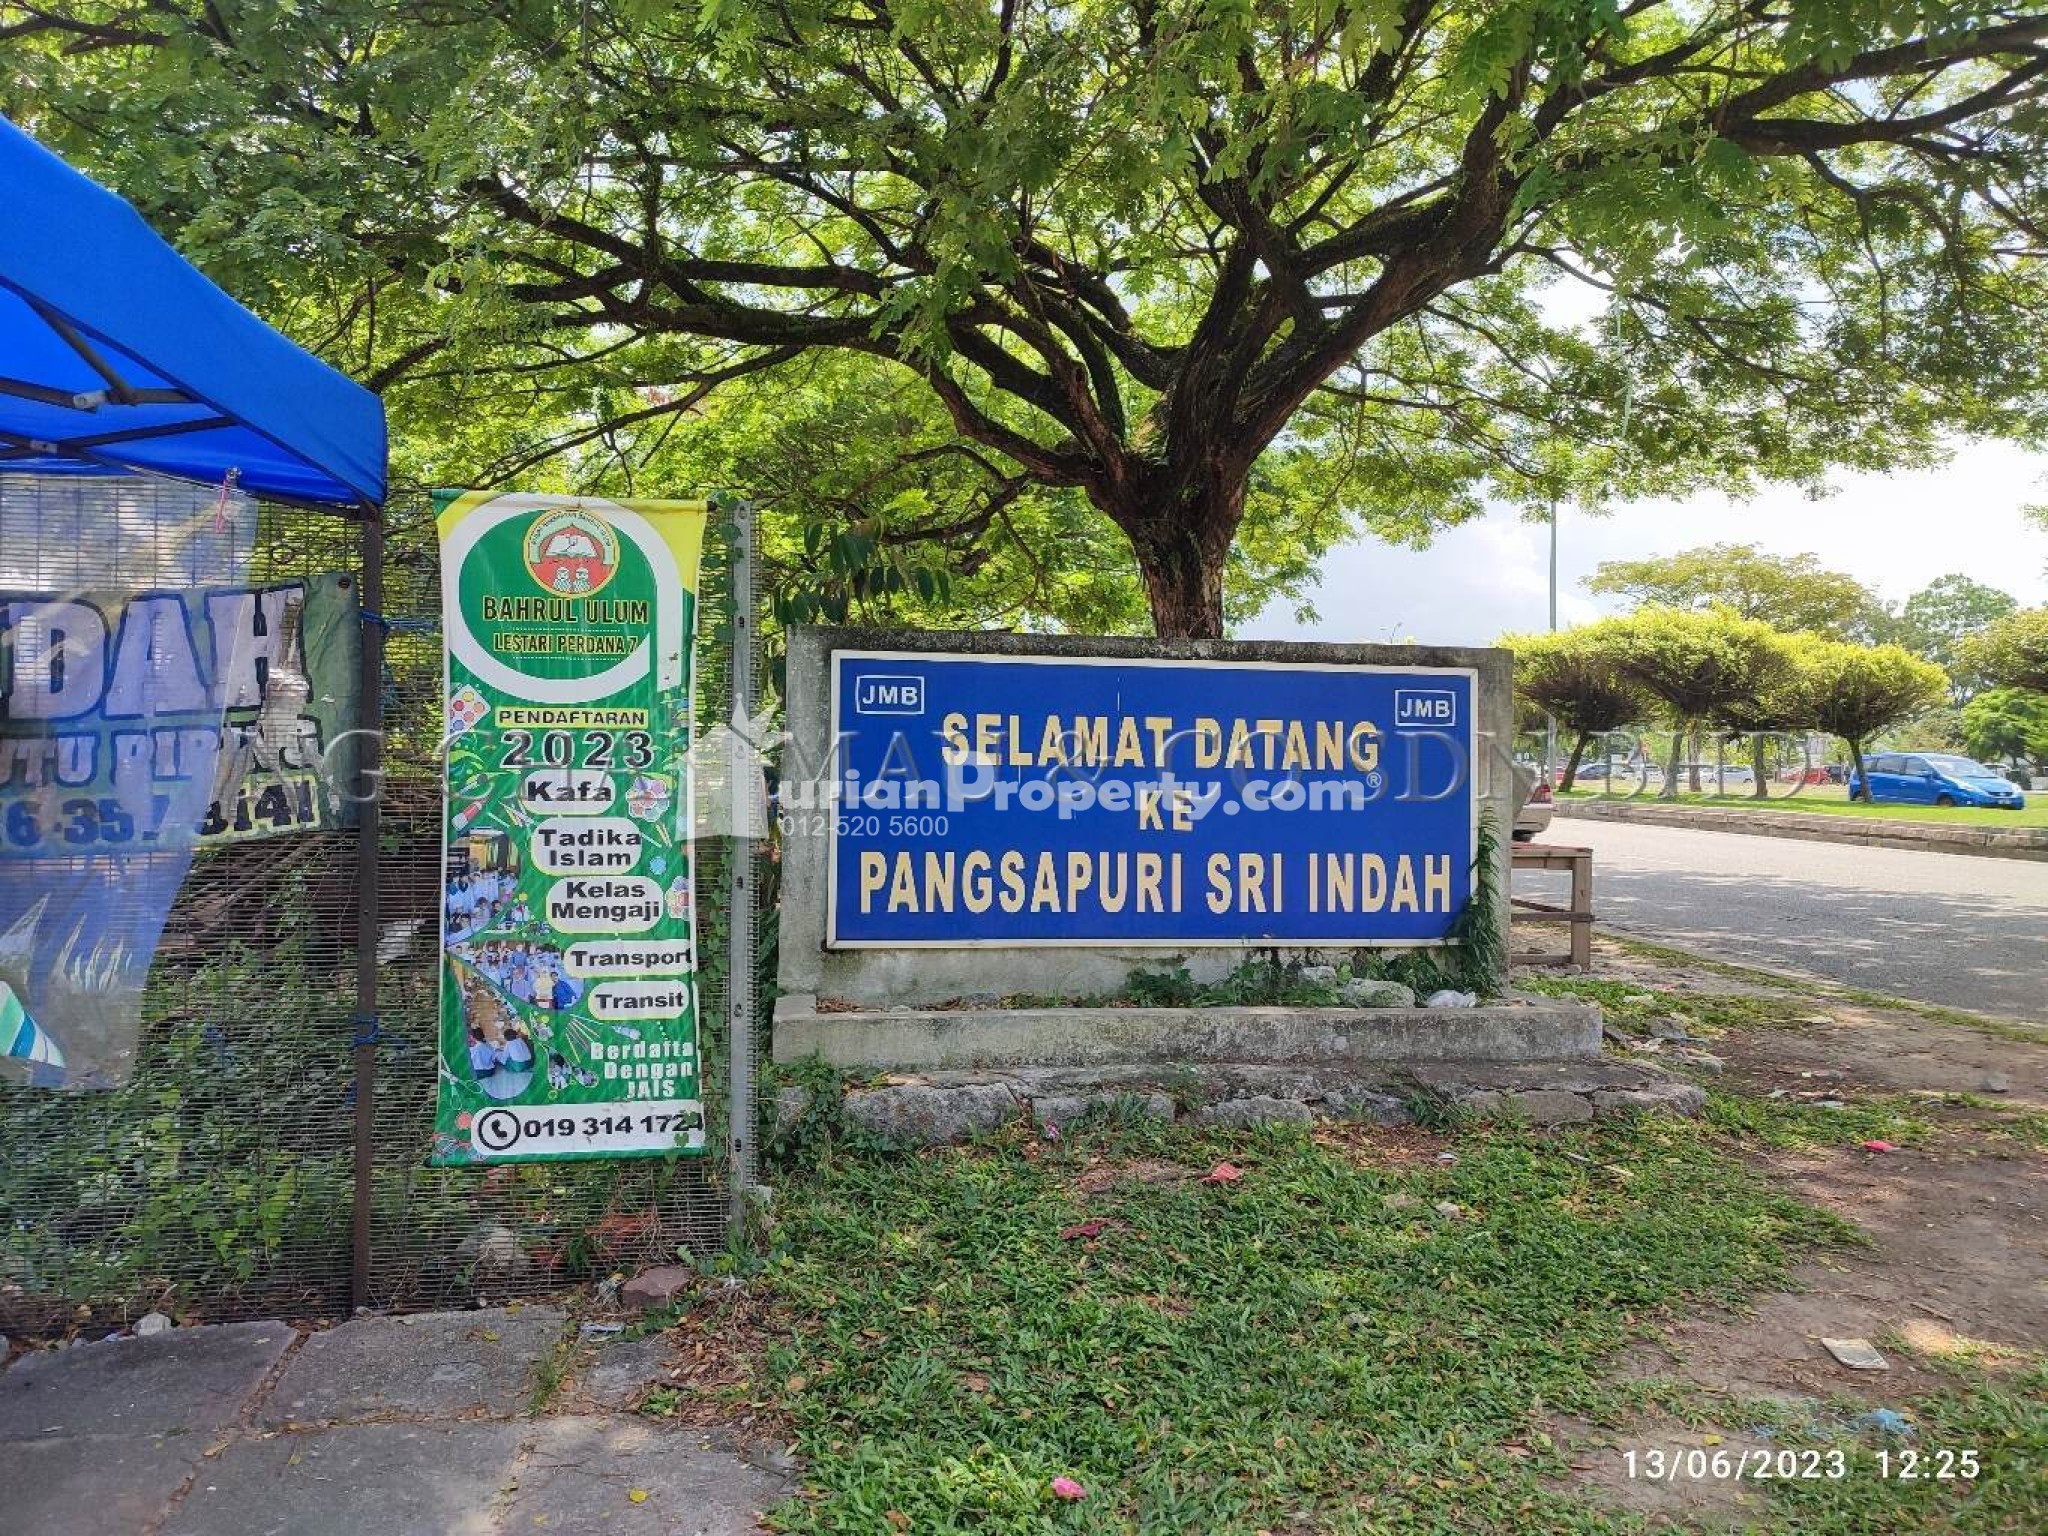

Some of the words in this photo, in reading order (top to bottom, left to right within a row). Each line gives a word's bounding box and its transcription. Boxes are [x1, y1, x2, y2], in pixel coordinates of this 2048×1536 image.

[483, 595, 577, 623] BAHRUL
[584, 599, 648, 624] ULUM
[493, 633, 554, 652] LESTARI
[557, 634, 624, 654] PERDANA
[628, 637, 638, 654] 7
[861, 685, 918, 706] JMB
[499, 710, 645, 725] PENDAFTARAN
[1400, 698, 1450, 718] JMB
[499, 730, 655, 769] 2023
[941, 712, 1172, 768] SELAMAT
[1195, 718, 1379, 772] DATANG
[527, 780, 612, 801] Kafa
[1139, 788, 1195, 832] KE
[538, 829, 642, 847] Tadika
[550, 850, 632, 866] Islam
[566, 881, 646, 899] Kelas
[860, 851, 1183, 914] PANGSAPURI
[1206, 852, 1283, 914] SRI
[1309, 852, 1451, 913] INDAH
[551, 901, 660, 922] Mengaji
[570, 948, 692, 968] Transport
[595, 992, 684, 1009] Transit
[604, 1062, 693, 1079] Dengan
[627, 1080, 675, 1098] JAIS
[524, 1118, 576, 1138] 019
[582, 1115, 633, 1135] 314
